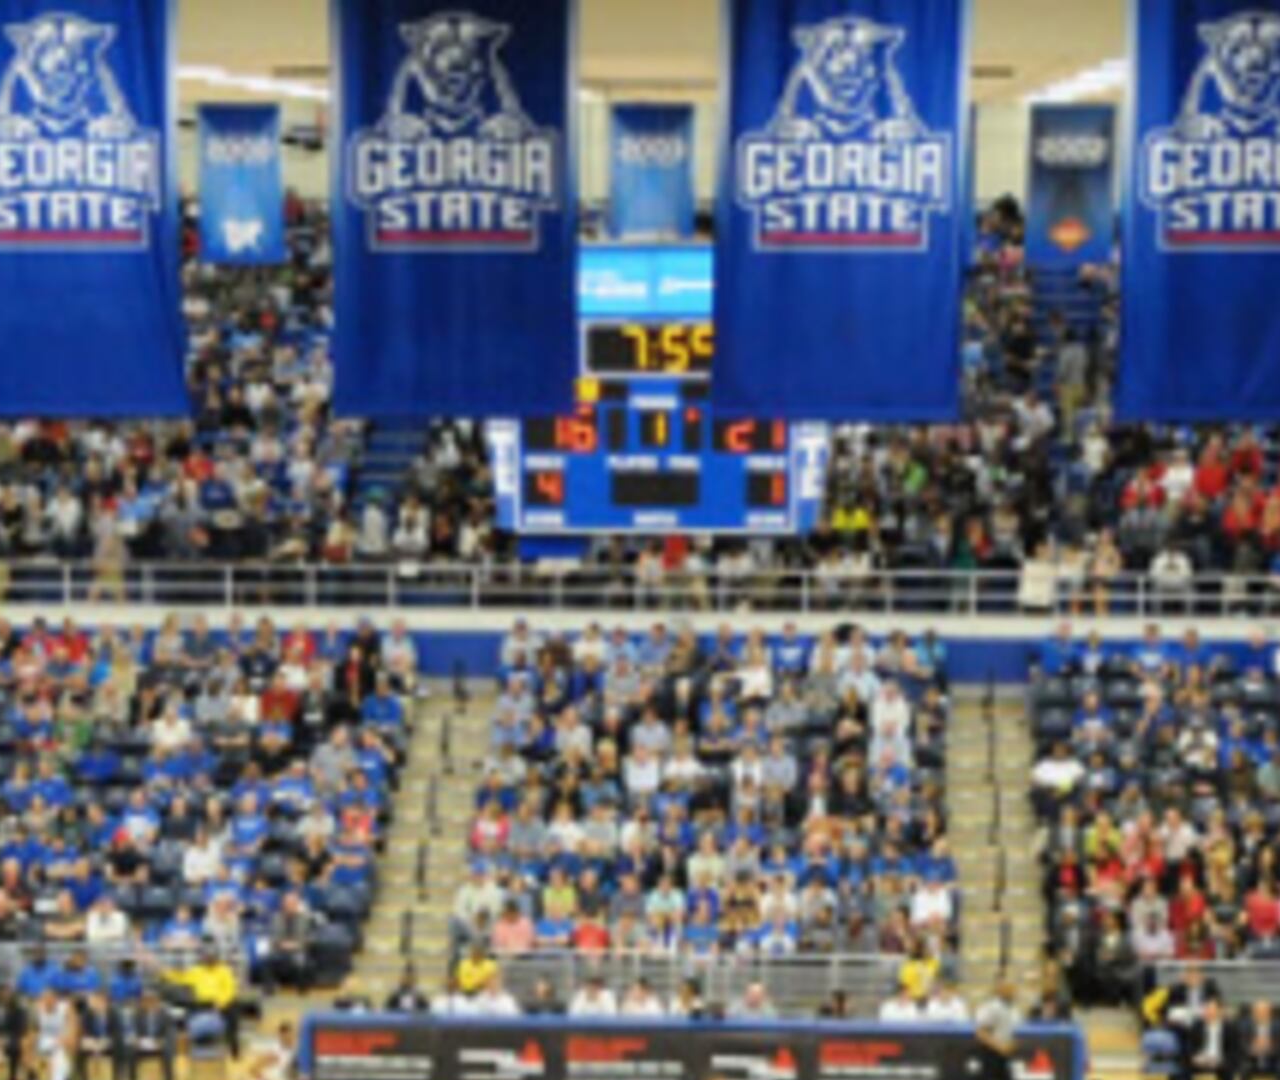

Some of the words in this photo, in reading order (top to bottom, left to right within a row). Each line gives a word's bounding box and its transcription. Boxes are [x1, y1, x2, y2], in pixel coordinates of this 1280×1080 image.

[357, 140, 554, 191] GEORGIA
[745, 142, 942, 194] GEORGIA
[379, 192, 534, 229] STATE
[765, 194, 922, 230] STATE
[655, 413, 666, 446] 1
[772, 471, 787, 504] 1
